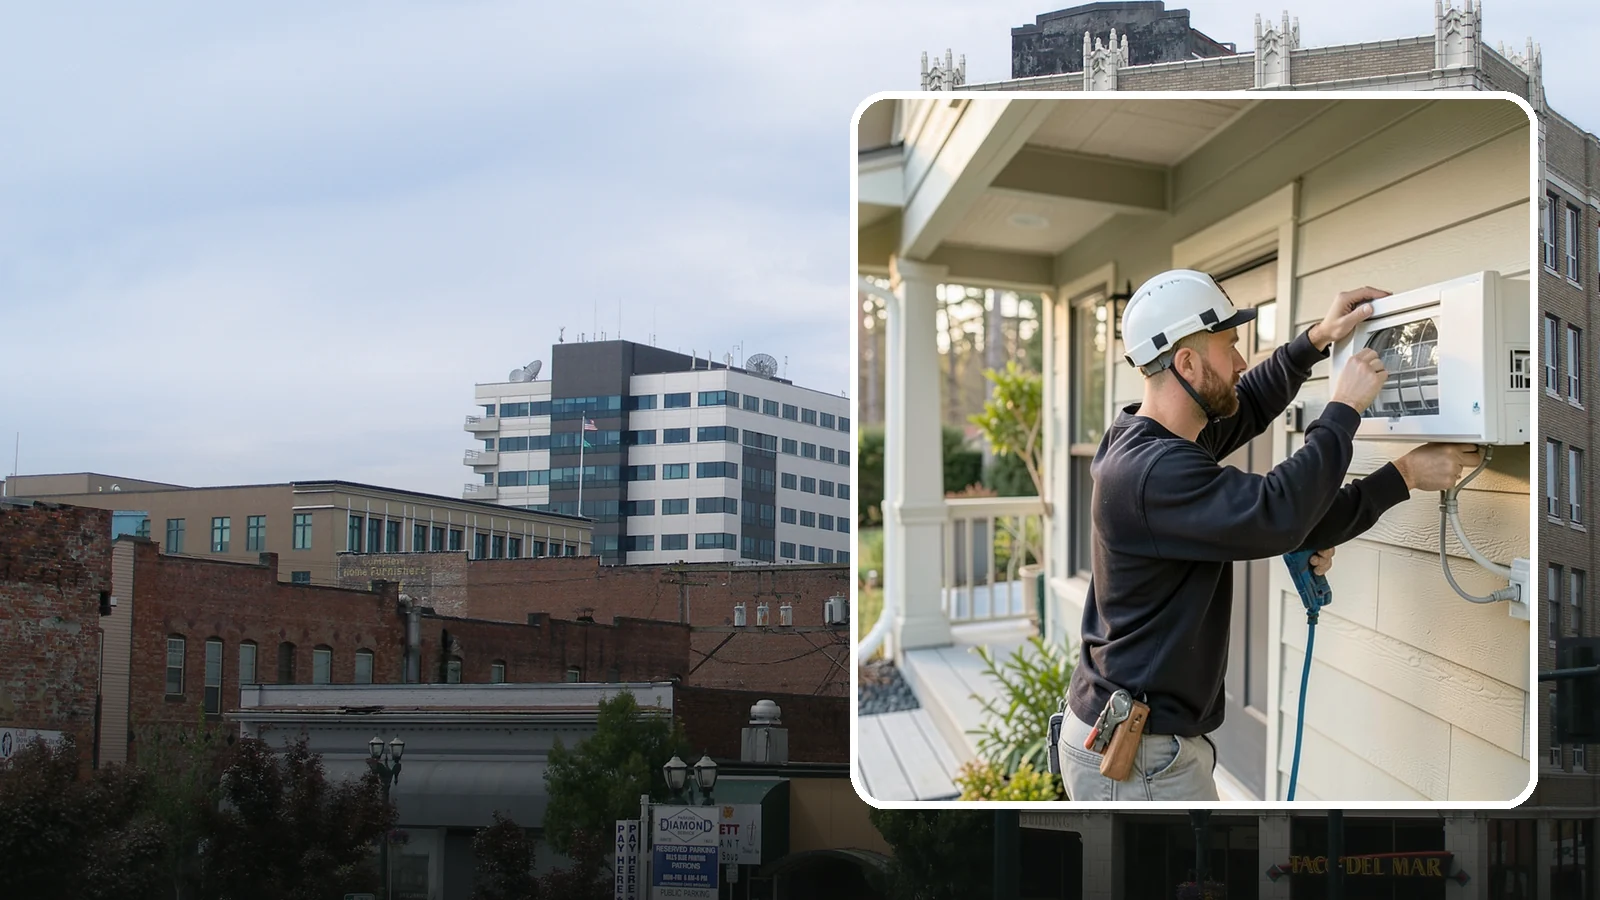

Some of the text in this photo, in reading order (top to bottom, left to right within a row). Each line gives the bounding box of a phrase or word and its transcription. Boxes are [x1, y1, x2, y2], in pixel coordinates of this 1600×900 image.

[370, 566, 427, 576] Furnishers
[660, 818, 713, 833] DIAMOND
[1021, 814, 1070, 828] BUILDING
[655, 845, 716, 854] RESERVED PARKING
[616, 824, 625, 893] PAY HERE
[627, 824, 637, 893] PAY HERE
[671, 862, 701, 870] PATRONS
[1346, 856, 1385, 875] DEL
[1392, 857, 1442, 876] MAR
[660, 888, 710, 898] PUBLIC PARKING
